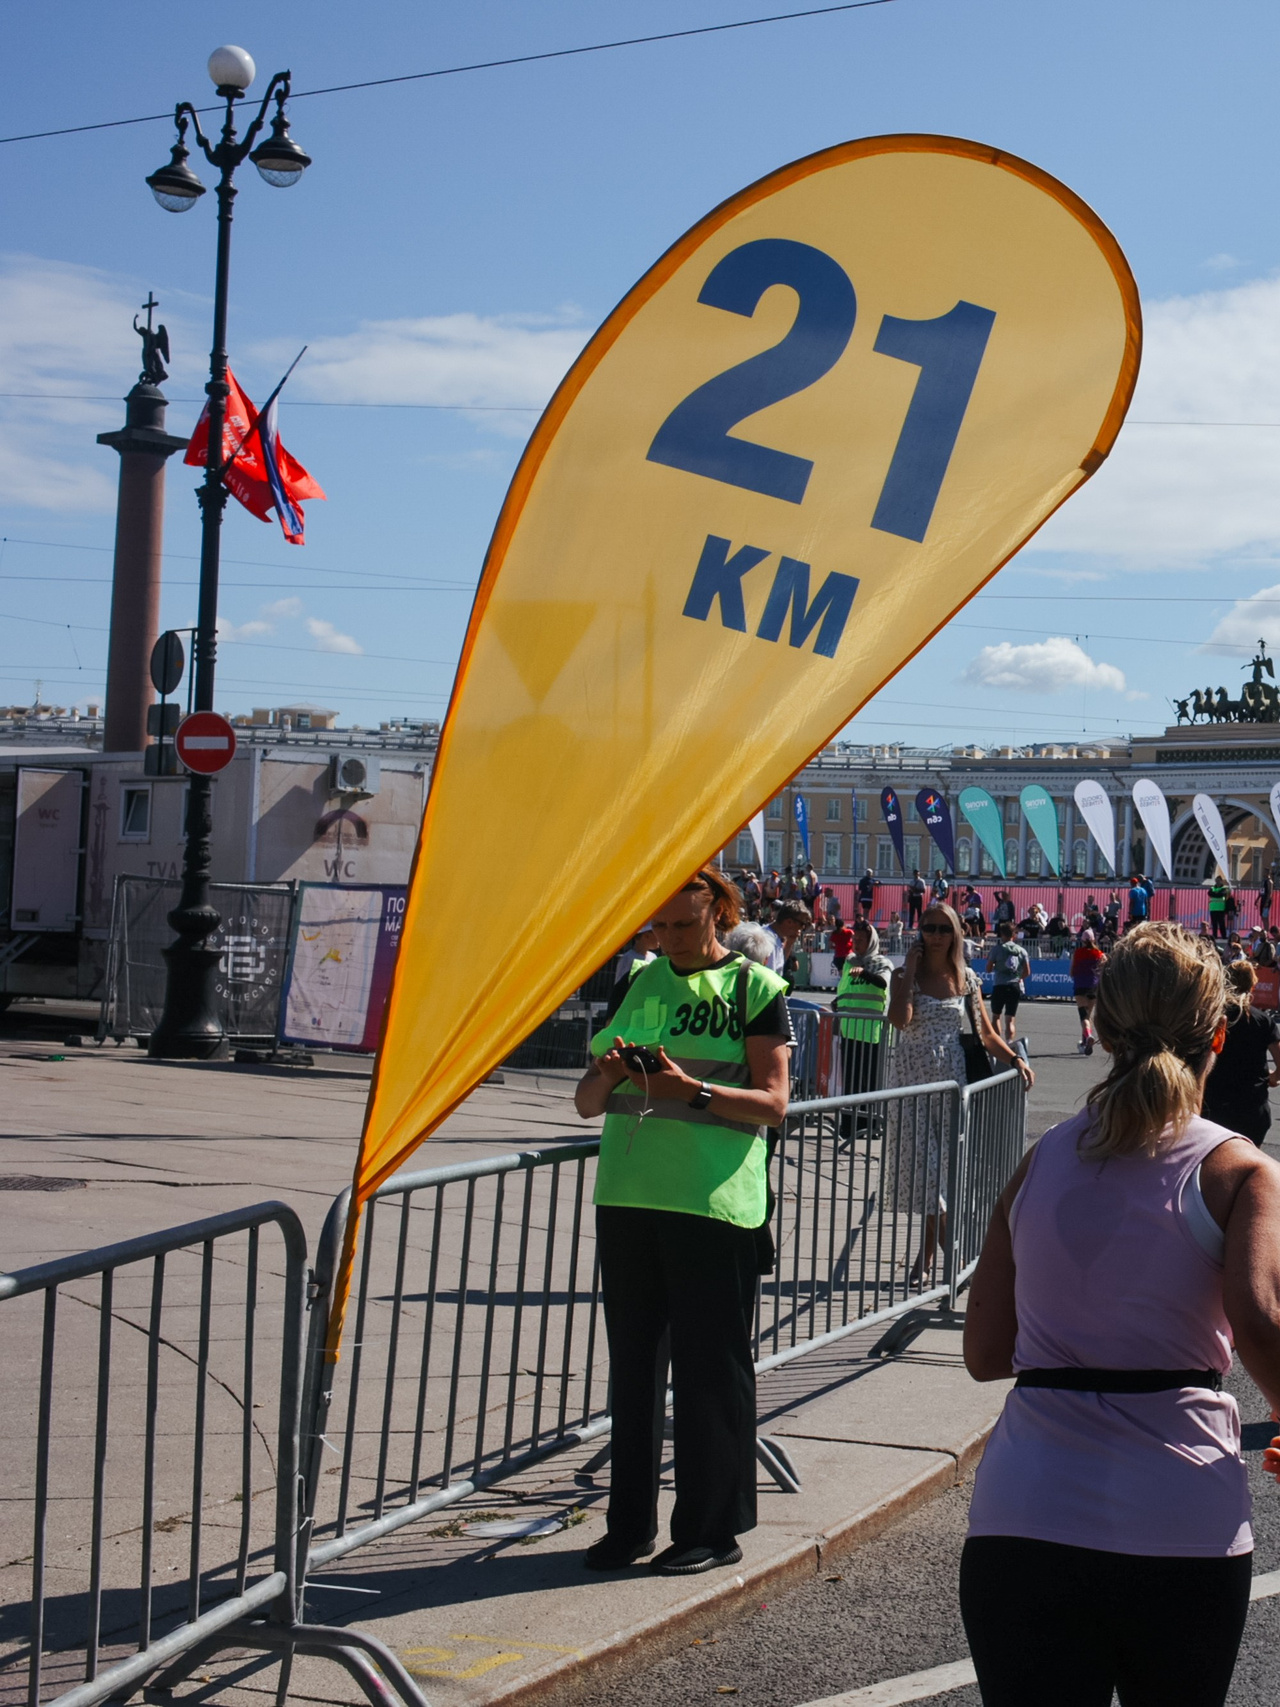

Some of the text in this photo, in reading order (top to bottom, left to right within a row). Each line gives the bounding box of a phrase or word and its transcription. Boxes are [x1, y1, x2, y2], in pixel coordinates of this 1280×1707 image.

[646, 238, 997, 544] 21
[38, 808, 60, 821] WC
[323, 859, 357, 879] WC
[387, 896, 405, 914] ПО
[384, 915, 403, 932] МА
